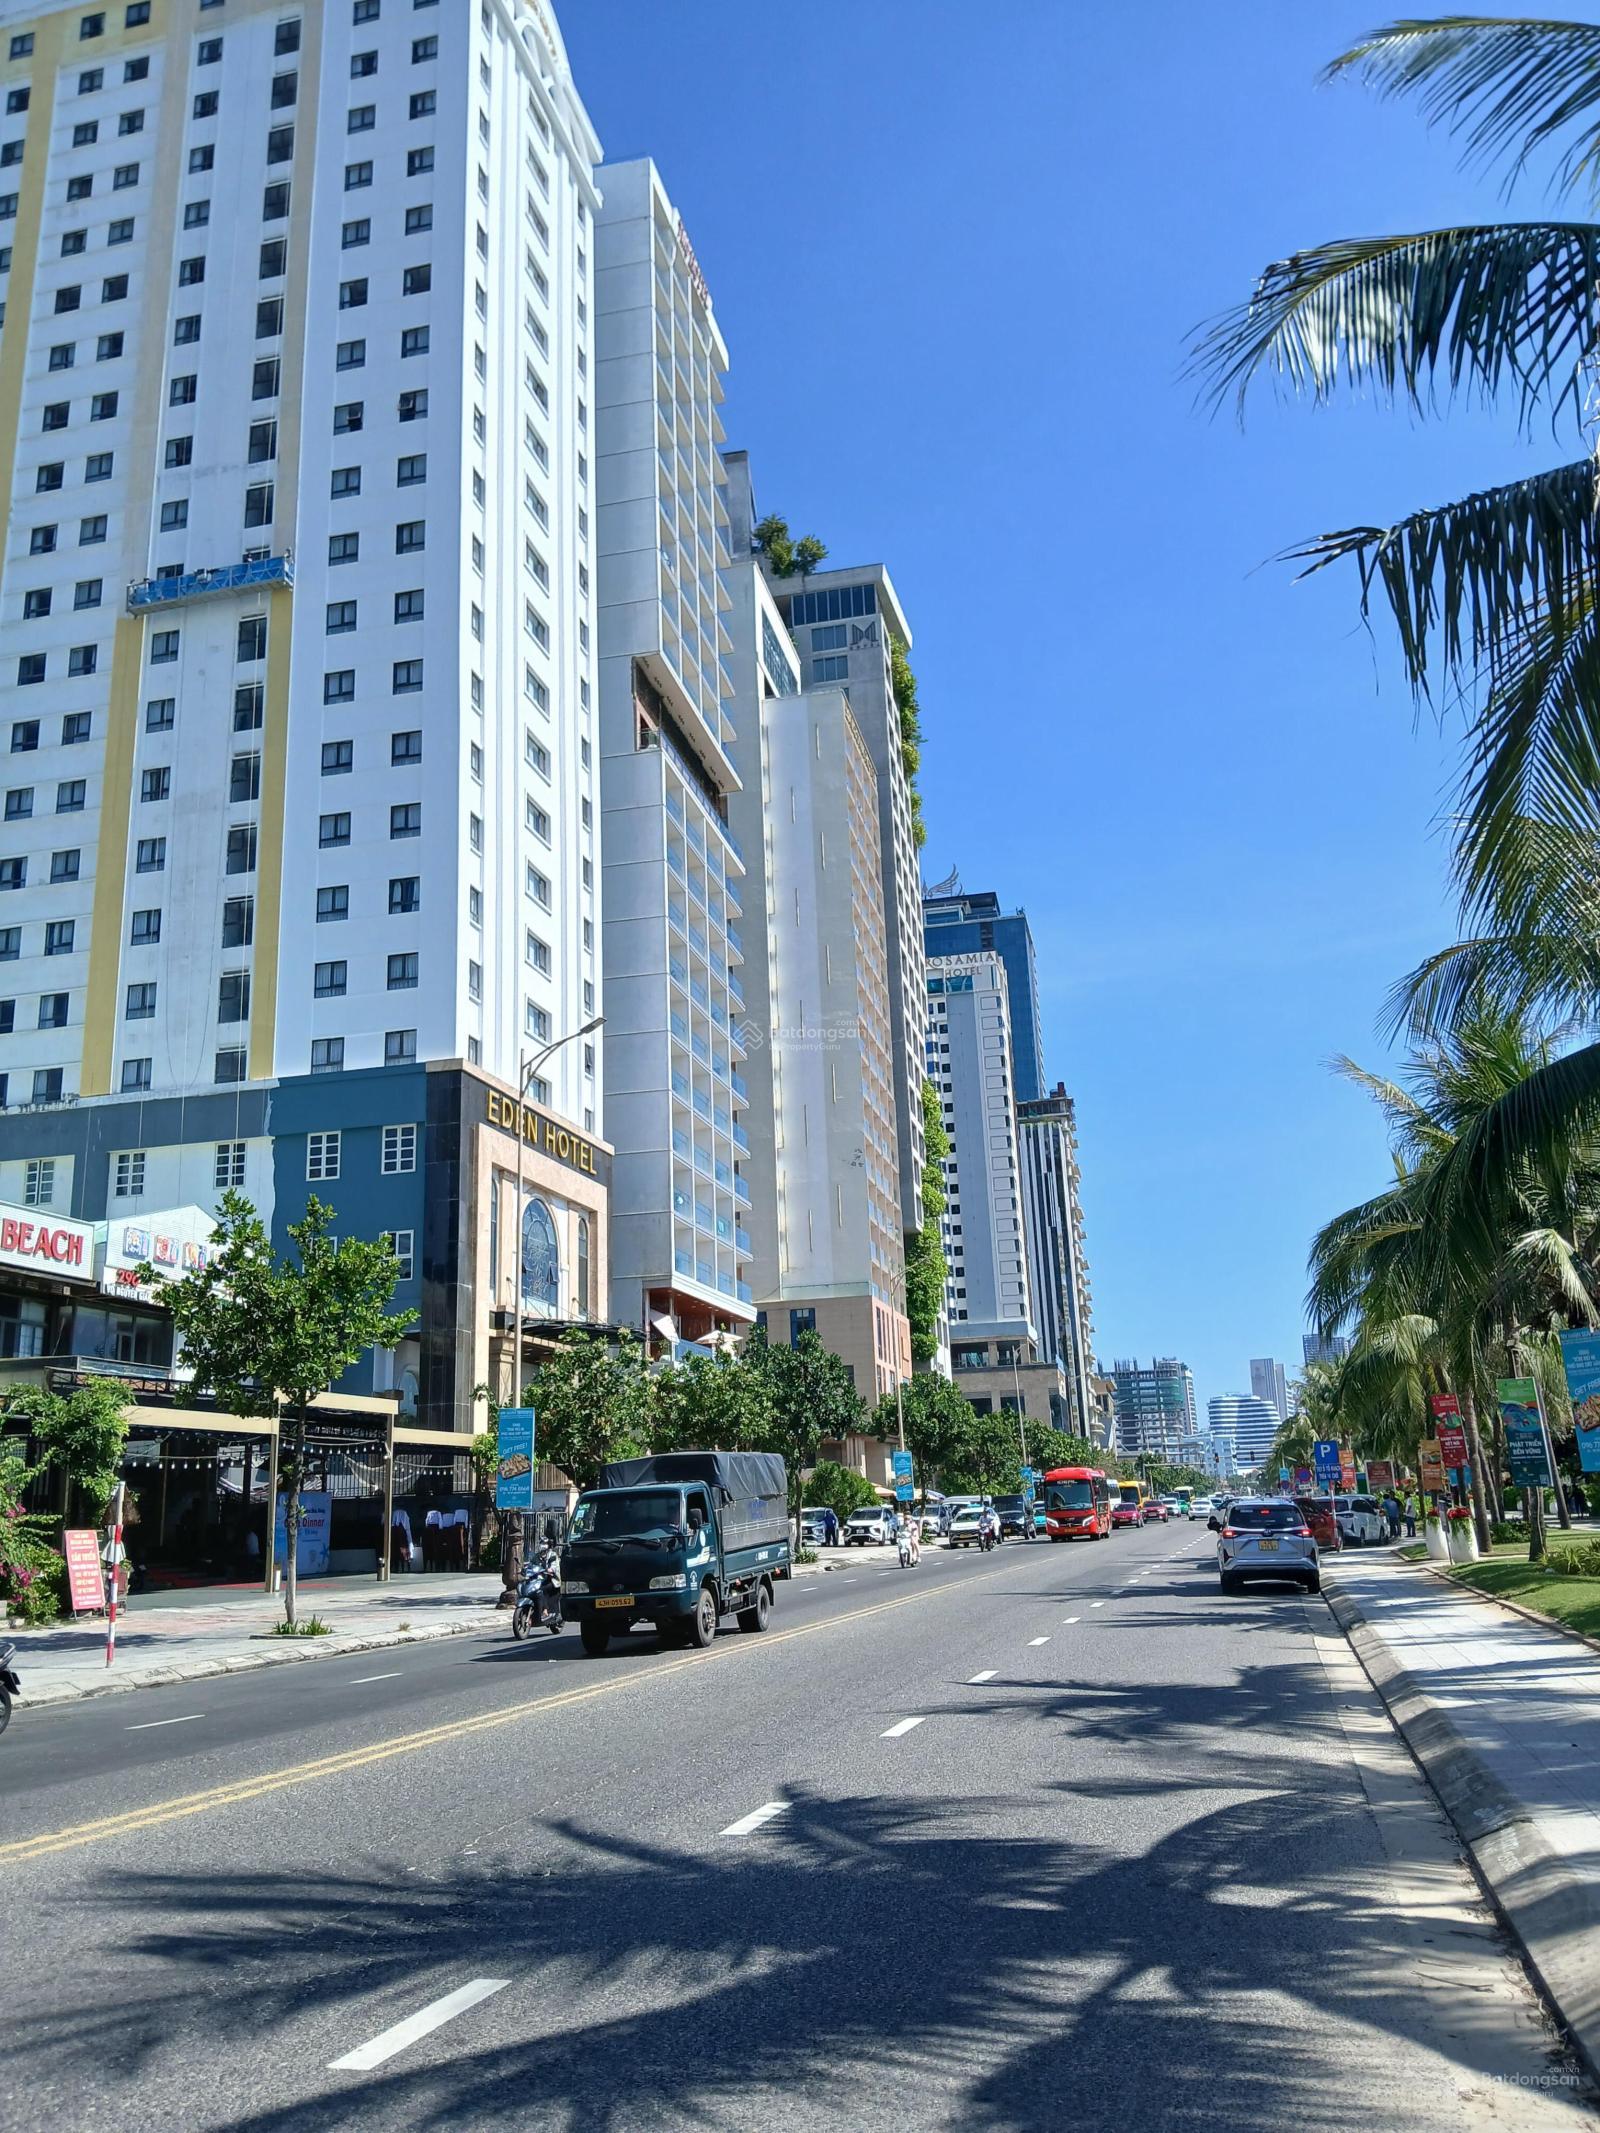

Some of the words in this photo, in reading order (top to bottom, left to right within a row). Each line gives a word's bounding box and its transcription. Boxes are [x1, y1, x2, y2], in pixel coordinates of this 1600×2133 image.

[925, 952, 995, 968] ROSAMIA
[945, 965, 982, 978] HOTEL
[487, 1089, 538, 1144] EDEN
[545, 1121, 598, 1176] HOTEL
[1, 1217, 84, 1266] BEACH
[1320, 1444, 1331, 1458] P
